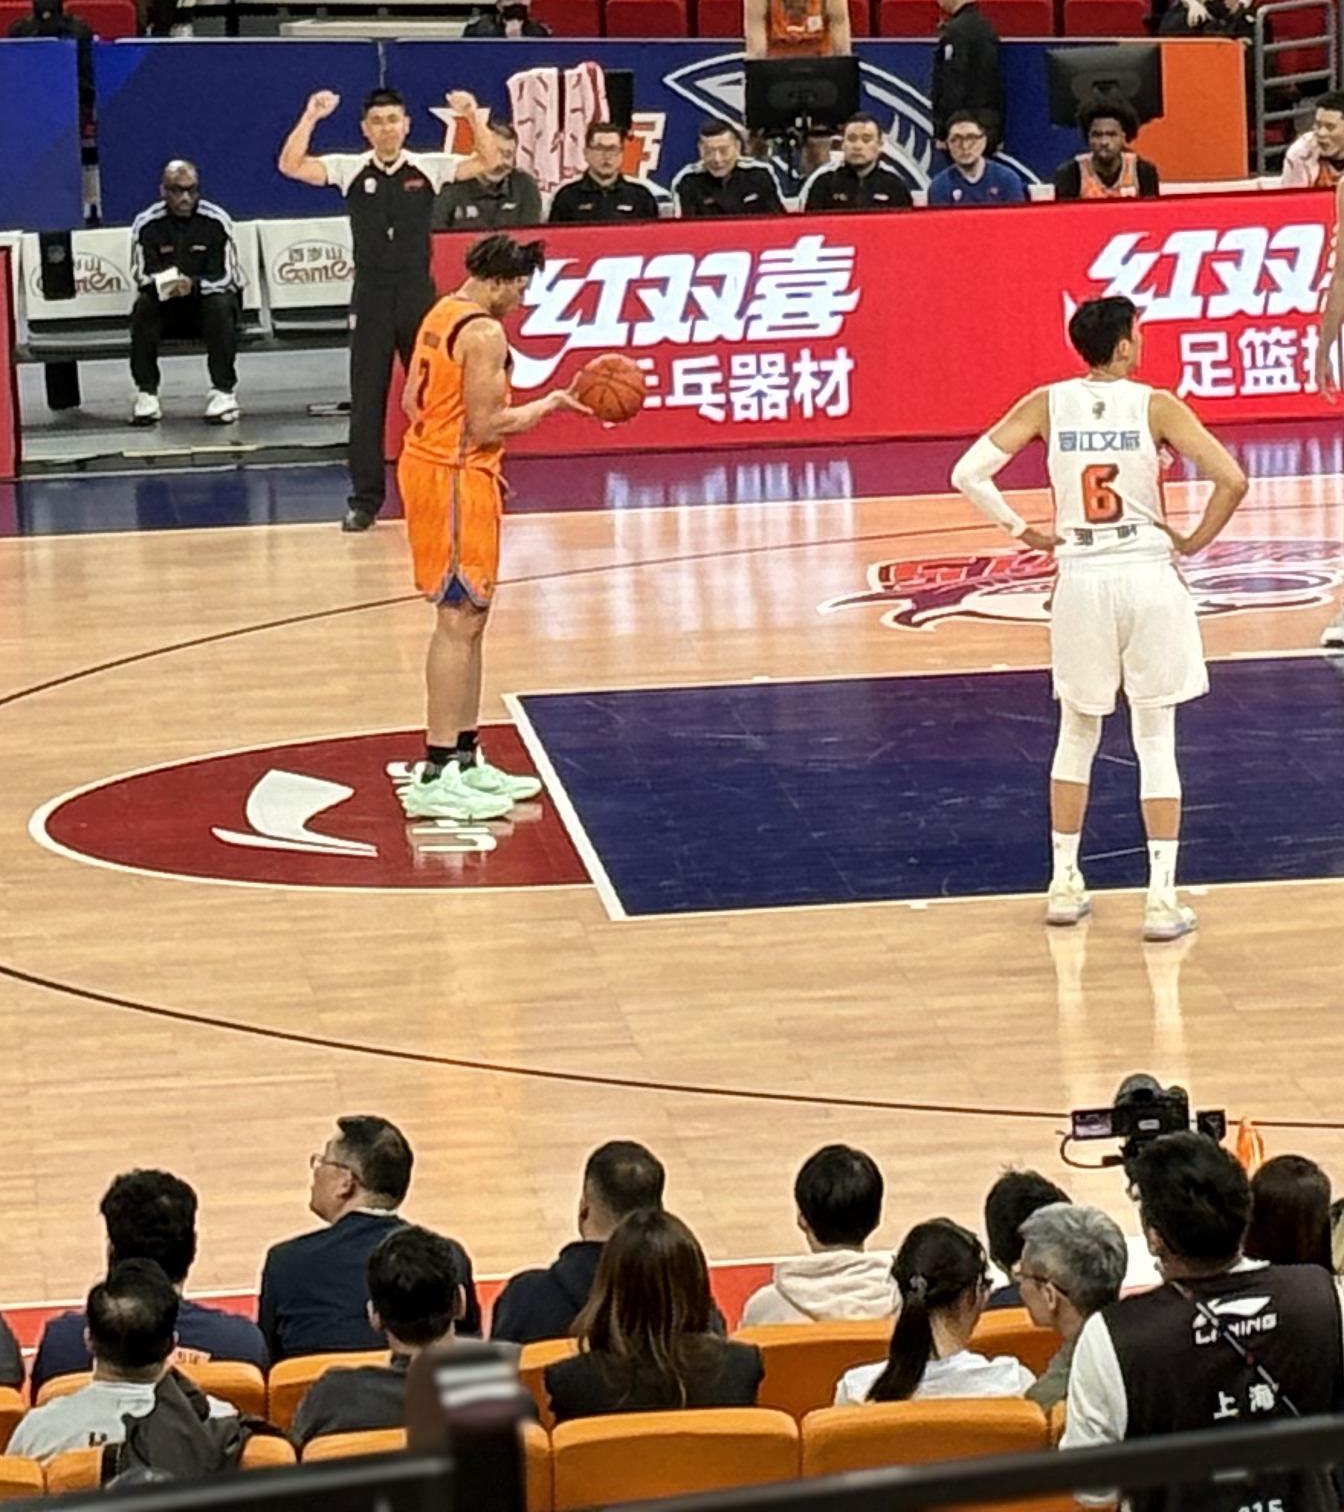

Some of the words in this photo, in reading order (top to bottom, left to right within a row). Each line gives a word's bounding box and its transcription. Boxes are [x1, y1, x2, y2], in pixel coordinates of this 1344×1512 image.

[1064, 224, 1328, 324] 红双
[509, 235, 861, 388] 红双喜
[1081, 463, 1124, 524] 6
[1195, 1313, 1277, 1345] LINING
[1213, 1383, 1275, 1420] 上海
